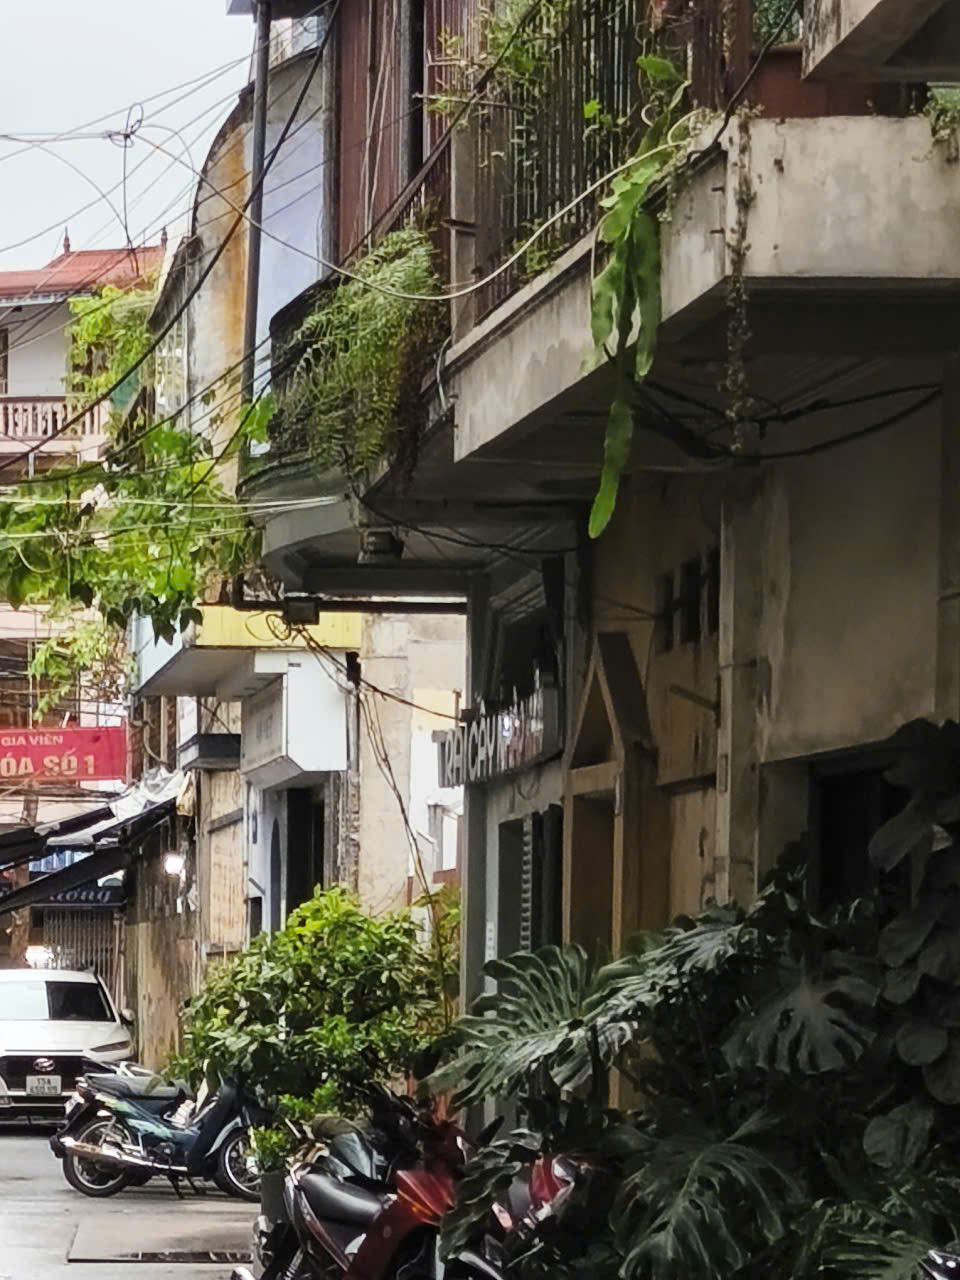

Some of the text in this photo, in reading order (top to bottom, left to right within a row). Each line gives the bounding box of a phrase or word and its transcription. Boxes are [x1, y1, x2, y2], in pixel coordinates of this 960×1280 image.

[1, 735, 27, 747] GIA
[29, 734, 64, 746] VIÊN
[43, 747, 78, 777] SỐ
[84, 754, 96, 775] 1
